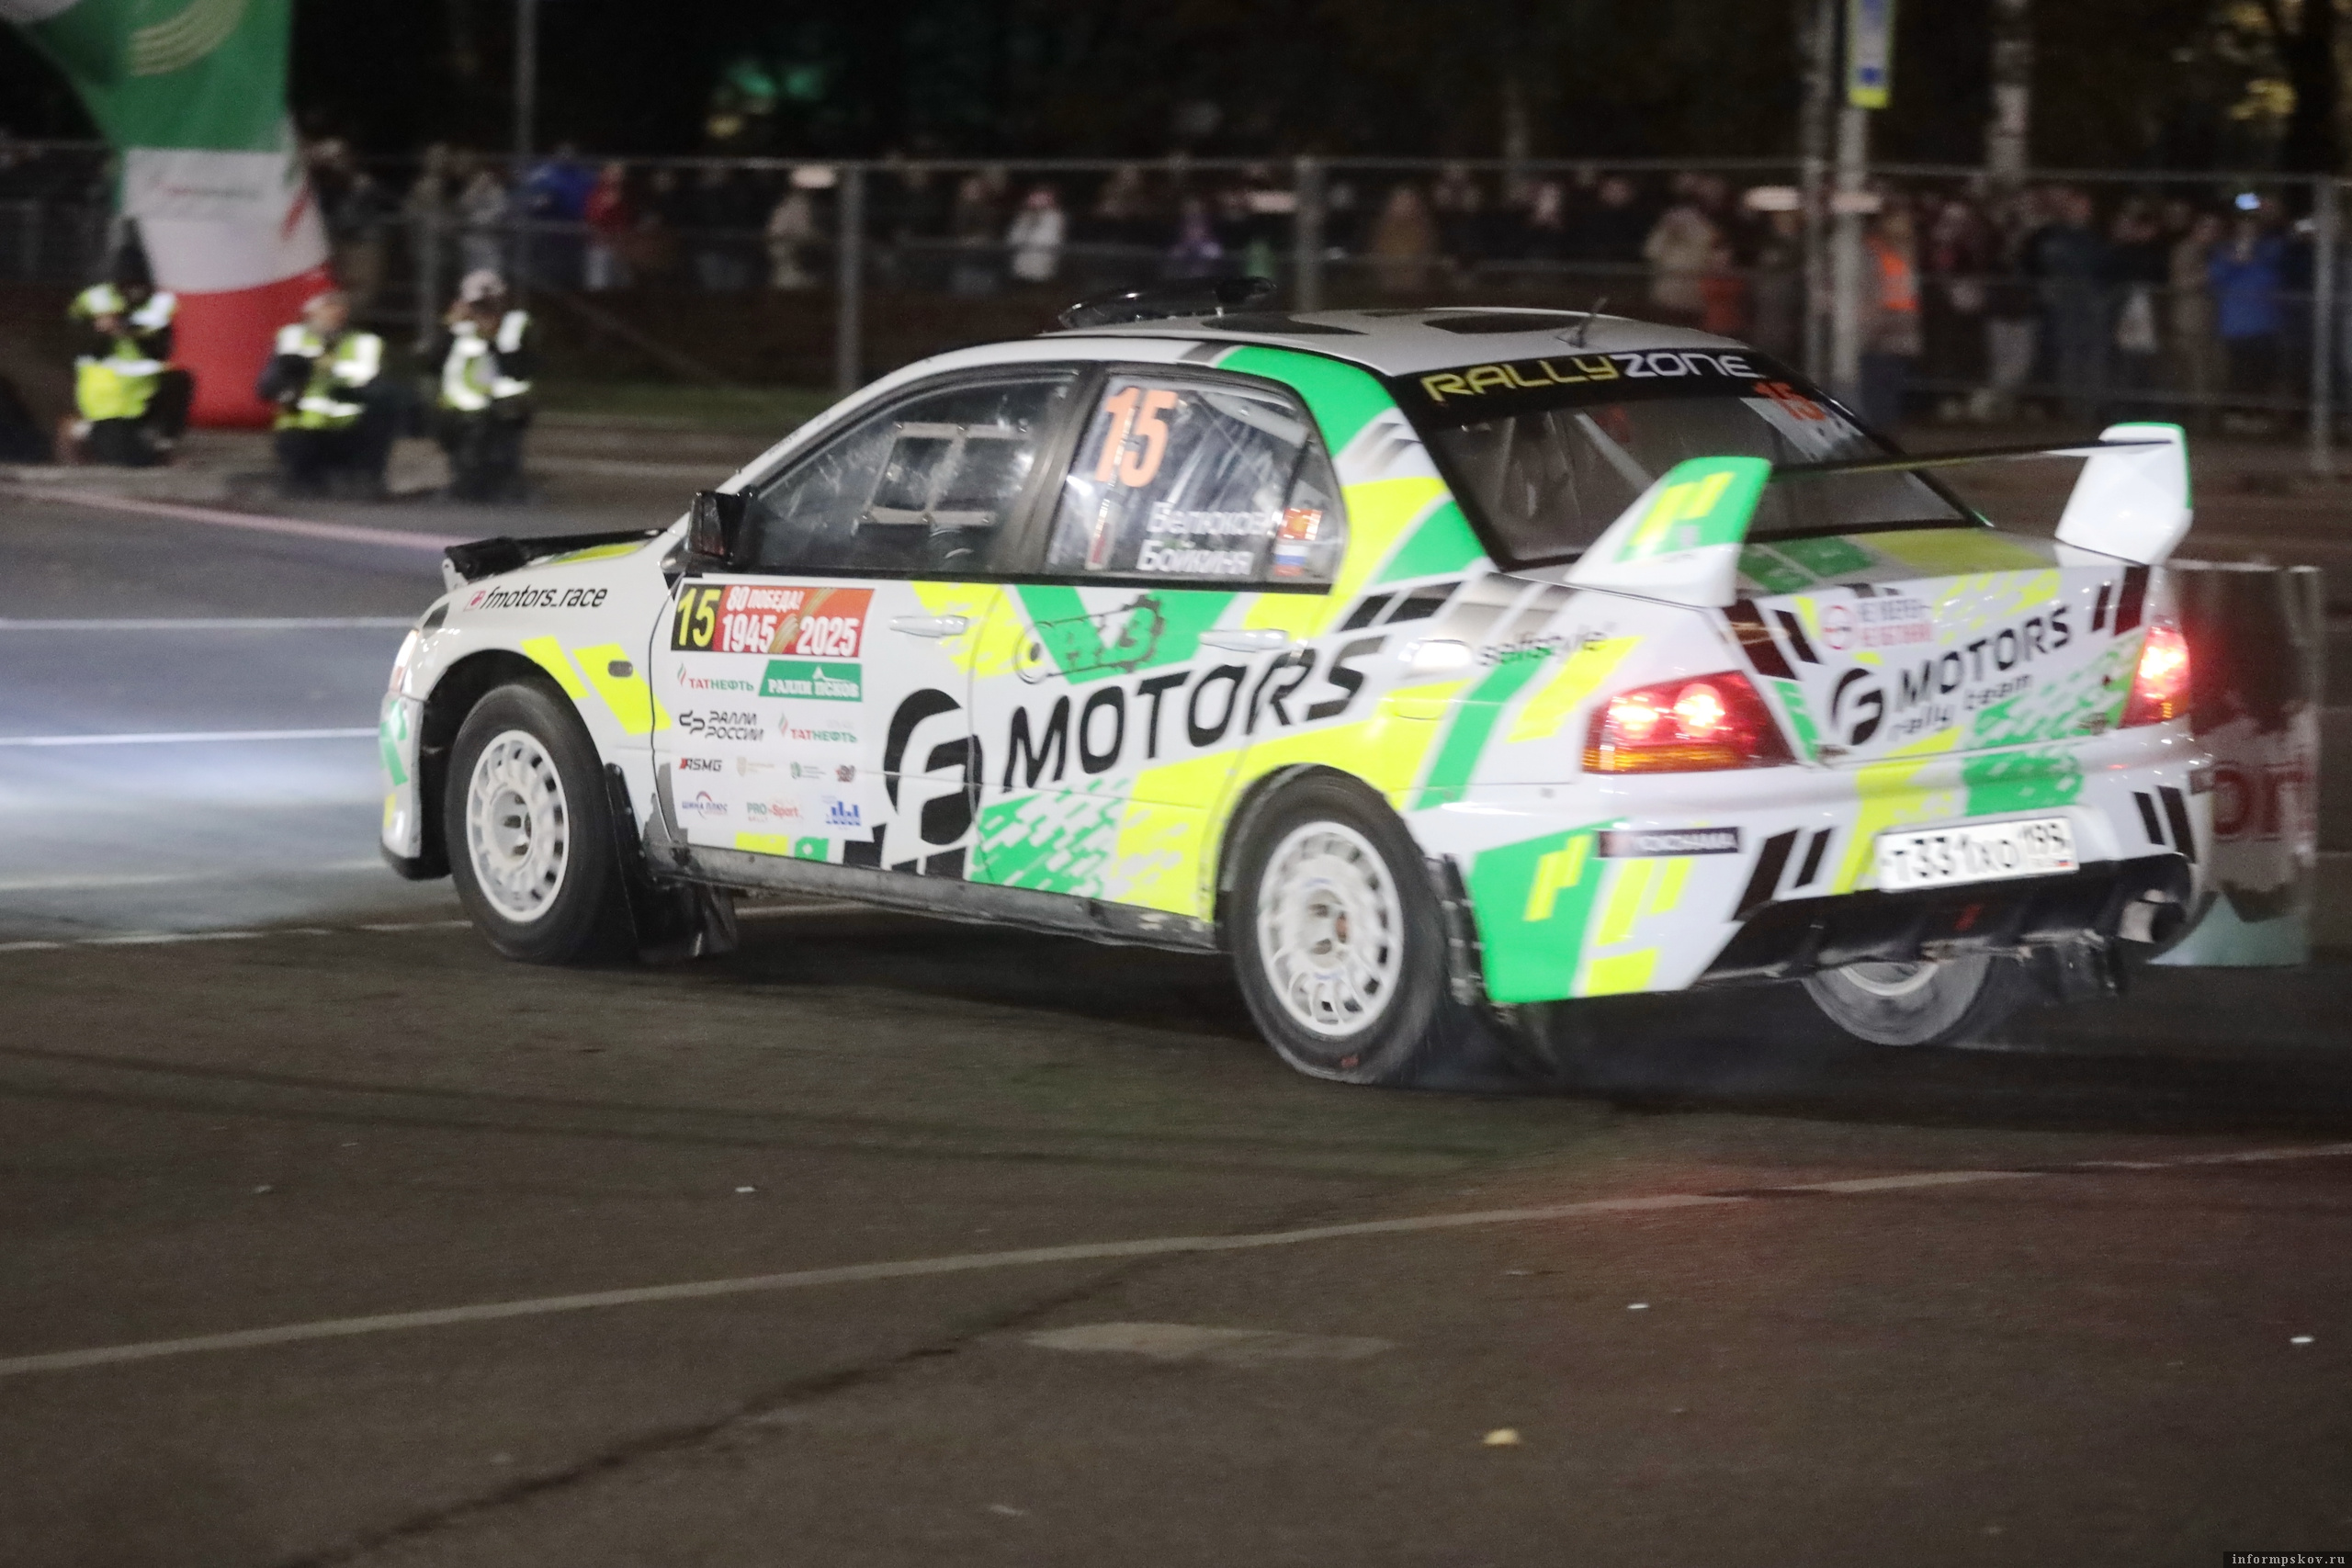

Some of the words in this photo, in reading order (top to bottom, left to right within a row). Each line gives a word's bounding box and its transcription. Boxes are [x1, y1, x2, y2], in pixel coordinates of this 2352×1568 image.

[1094, 387, 1179, 487] 15
[480, 585, 608, 609] fmotors_race
[726, 586, 750, 611] 80
[677, 588, 721, 648] 15
[722, 614, 777, 653] 1945
[796, 615, 860, 657] 2025
[1897, 605, 2072, 712] MOTORS
[689, 678, 754, 691] ТАТНЕФТЬ
[709, 710, 757, 726] РАЛЛИ
[1003, 635, 1387, 793] MOTORS
[705, 727, 764, 741] РОССИИ
[790, 728, 858, 743] ТАТНЕФТЬ
